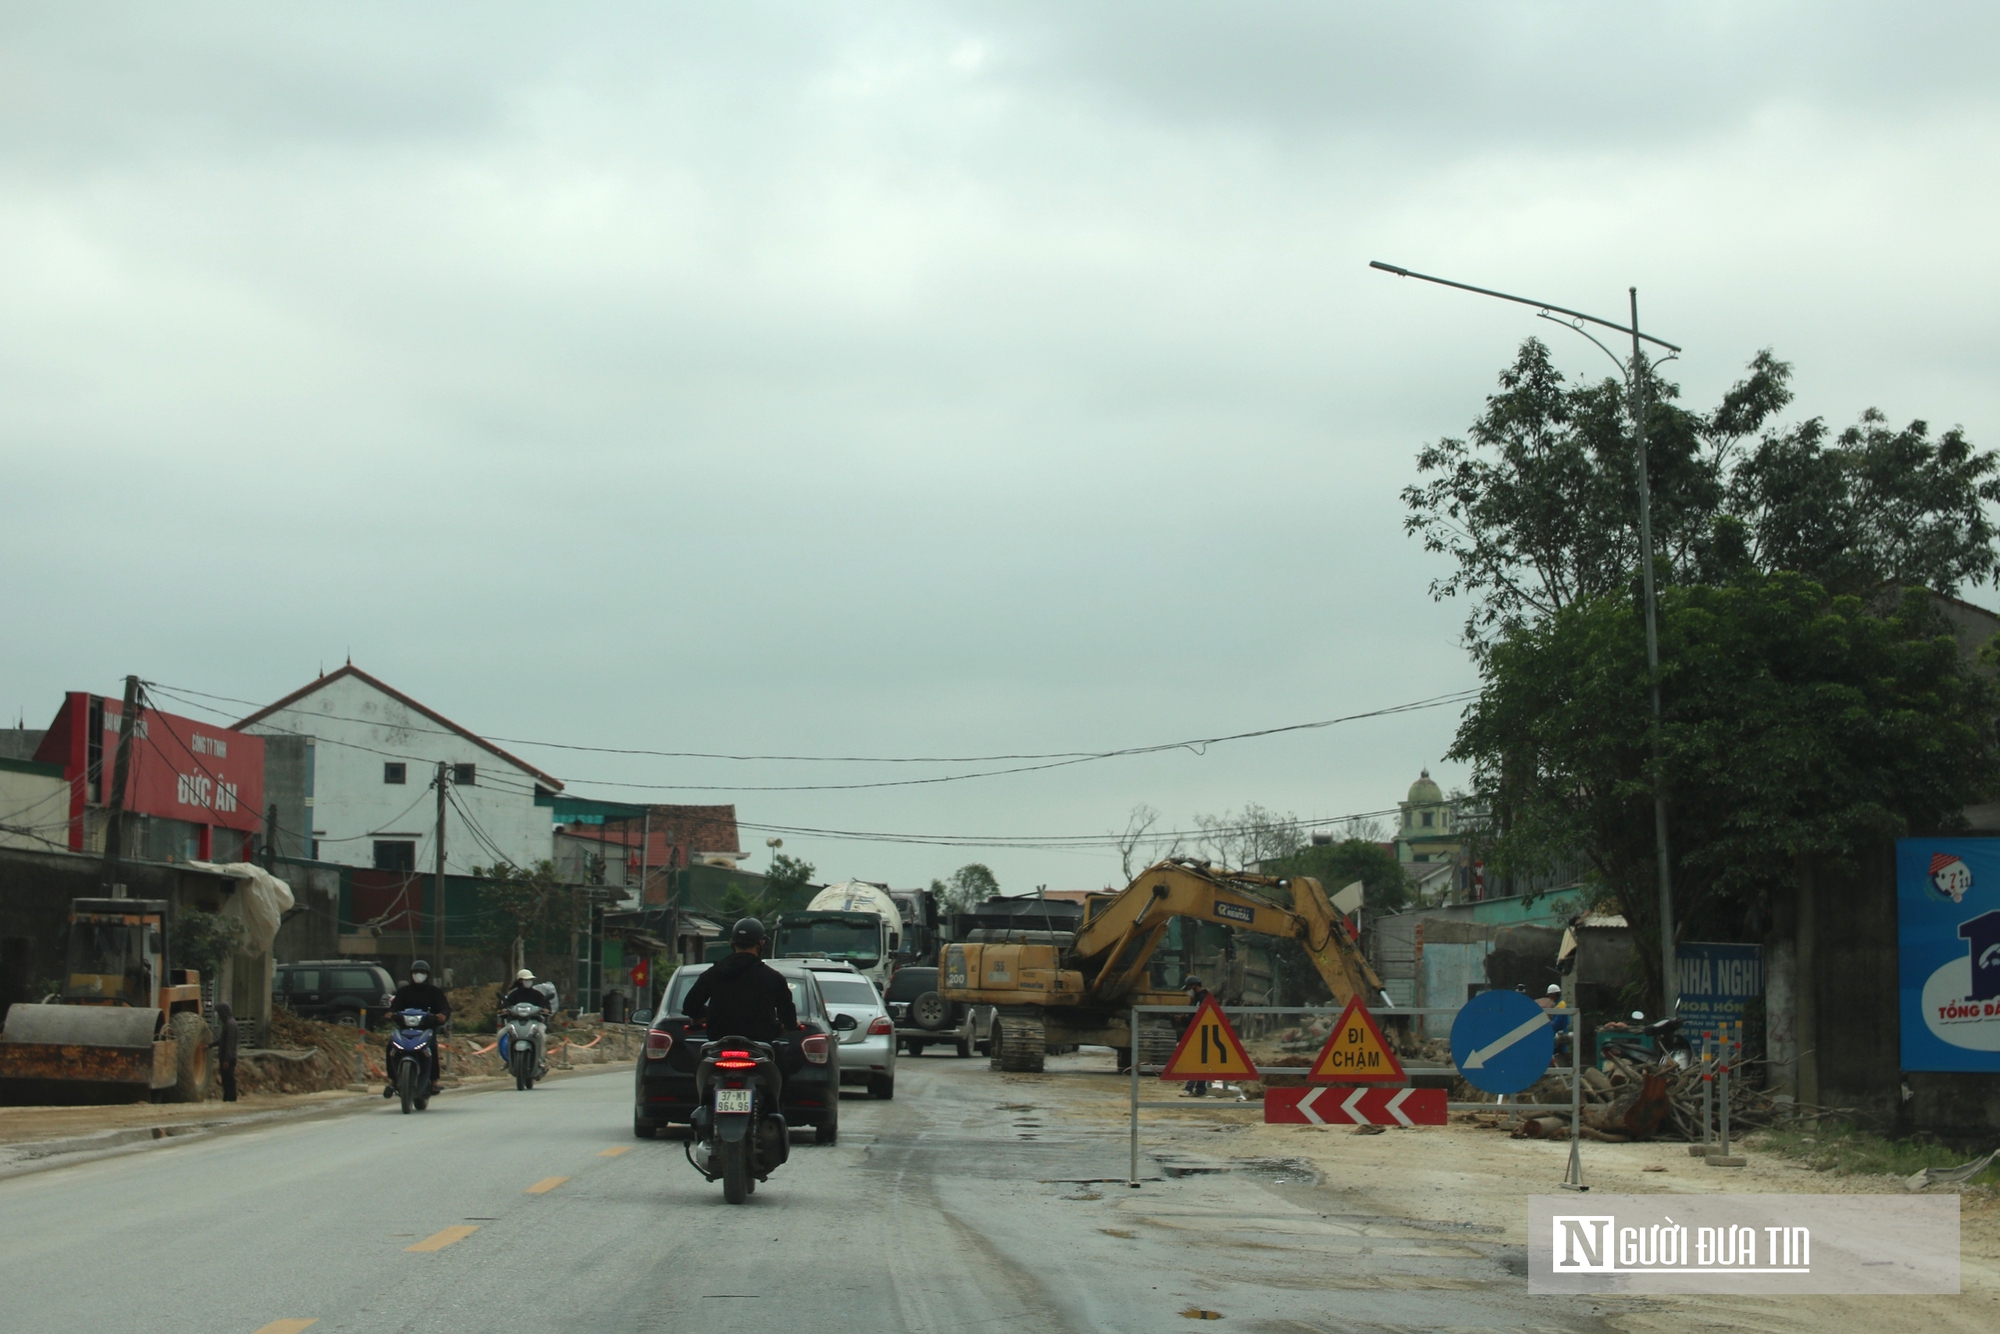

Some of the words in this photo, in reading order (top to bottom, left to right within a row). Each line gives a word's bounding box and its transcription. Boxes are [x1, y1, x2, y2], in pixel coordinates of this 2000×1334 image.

[192, 731, 206, 754] CÔNG
[207, 738, 213, 756] TY
[214, 739, 227, 759] TNHH
[177, 768, 211, 808] ĐỨC
[215, 773, 238, 812] ÂN
[947, 974, 965, 984] 200
[1677, 951, 1713, 995] NHÀ
[1718, 947, 1760, 996] NGHỈ
[1679, 1001, 1710, 1013] HOA
[1938, 999, 1980, 1019] TỔNG
[1348, 1028, 1364, 1044] ĐI
[1332, 1047, 1380, 1070] CHẬM
[721, 1091, 747, 1101] 37-M1
[717, 1101, 750, 1112] 964.96
